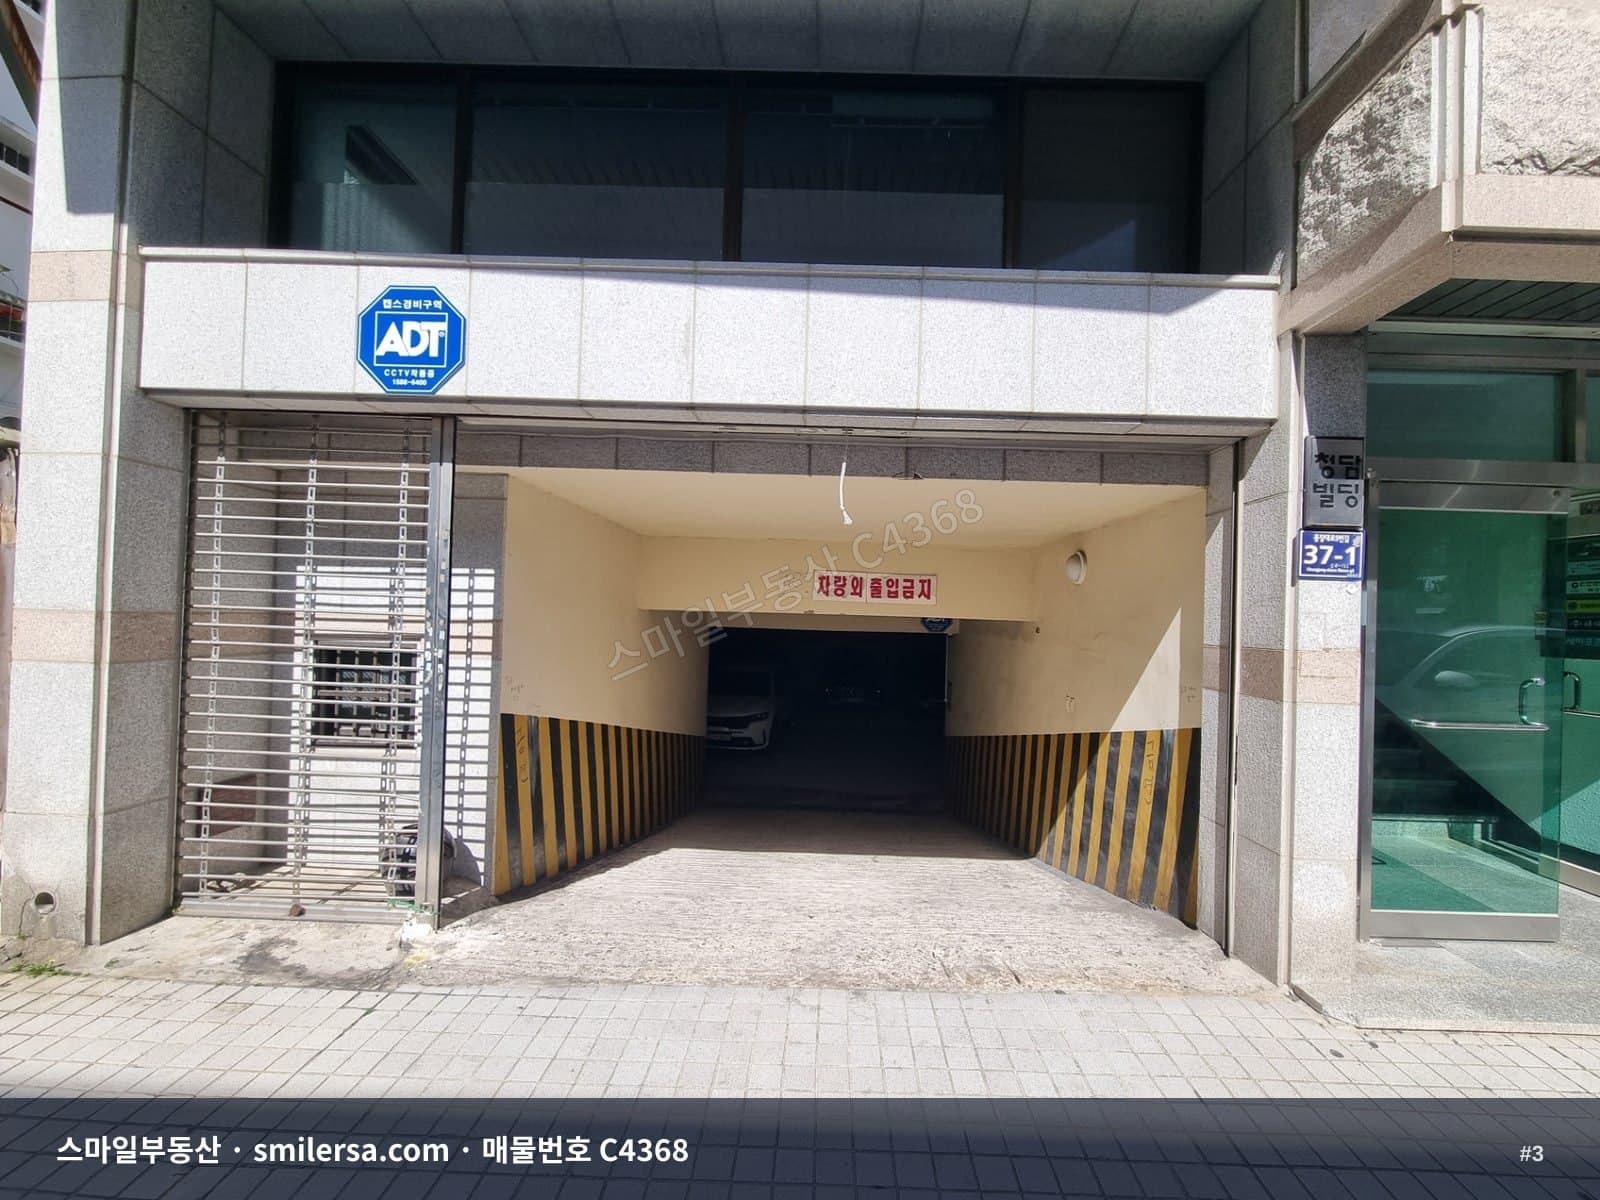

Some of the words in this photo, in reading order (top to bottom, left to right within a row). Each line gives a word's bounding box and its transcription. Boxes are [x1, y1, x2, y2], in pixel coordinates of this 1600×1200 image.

[376, 321, 447, 357] ADT
[1314, 452, 1362, 479] 청담
[1313, 483, 1359, 508] 빌딩
[1303, 544, 1356, 566] 37-1
[869, 577, 932, 600] 출입금지
